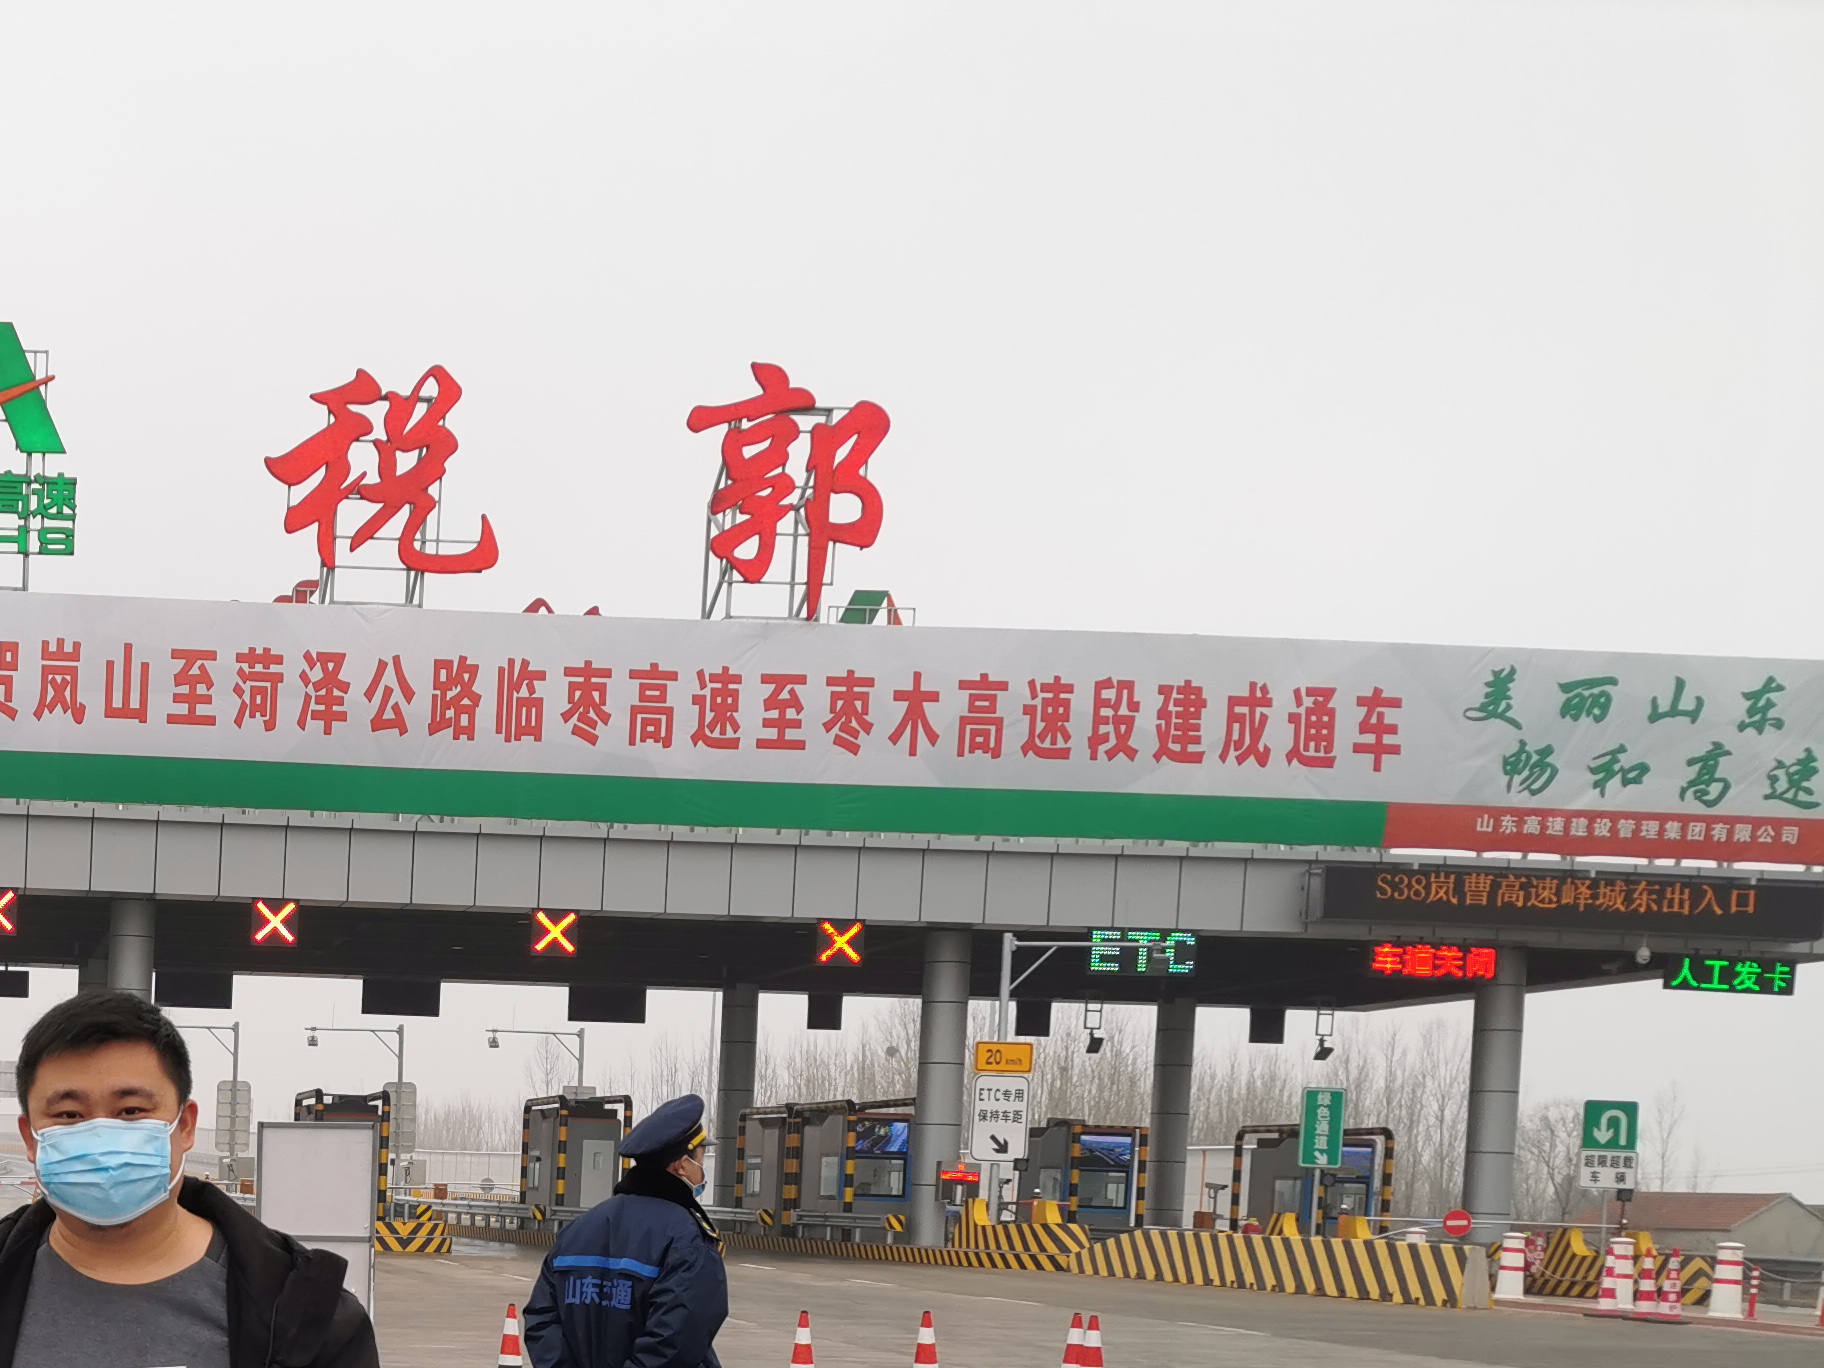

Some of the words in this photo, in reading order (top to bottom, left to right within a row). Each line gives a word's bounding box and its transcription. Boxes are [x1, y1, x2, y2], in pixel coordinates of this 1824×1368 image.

[1463, 664, 1787, 735] 美丽山东
[1502, 739, 1823, 810] 畅和高速
[1476, 814, 1800, 845] 山东高速建设管理集团有限公司
[1376, 872, 1756, 916] S38岚曹高速峄城东出入口
[1090, 930, 1196, 973] ETC
[1372, 943, 1496, 979] 车道关闭
[1671, 958, 1792, 991] 人工发卡
[985, 1049, 1002, 1066] 20
[978, 1088, 1025, 1103] ETC专用
[978, 1109, 1023, 1124] 保持车距
[1314, 1091, 1332, 1150] 绿色通道
